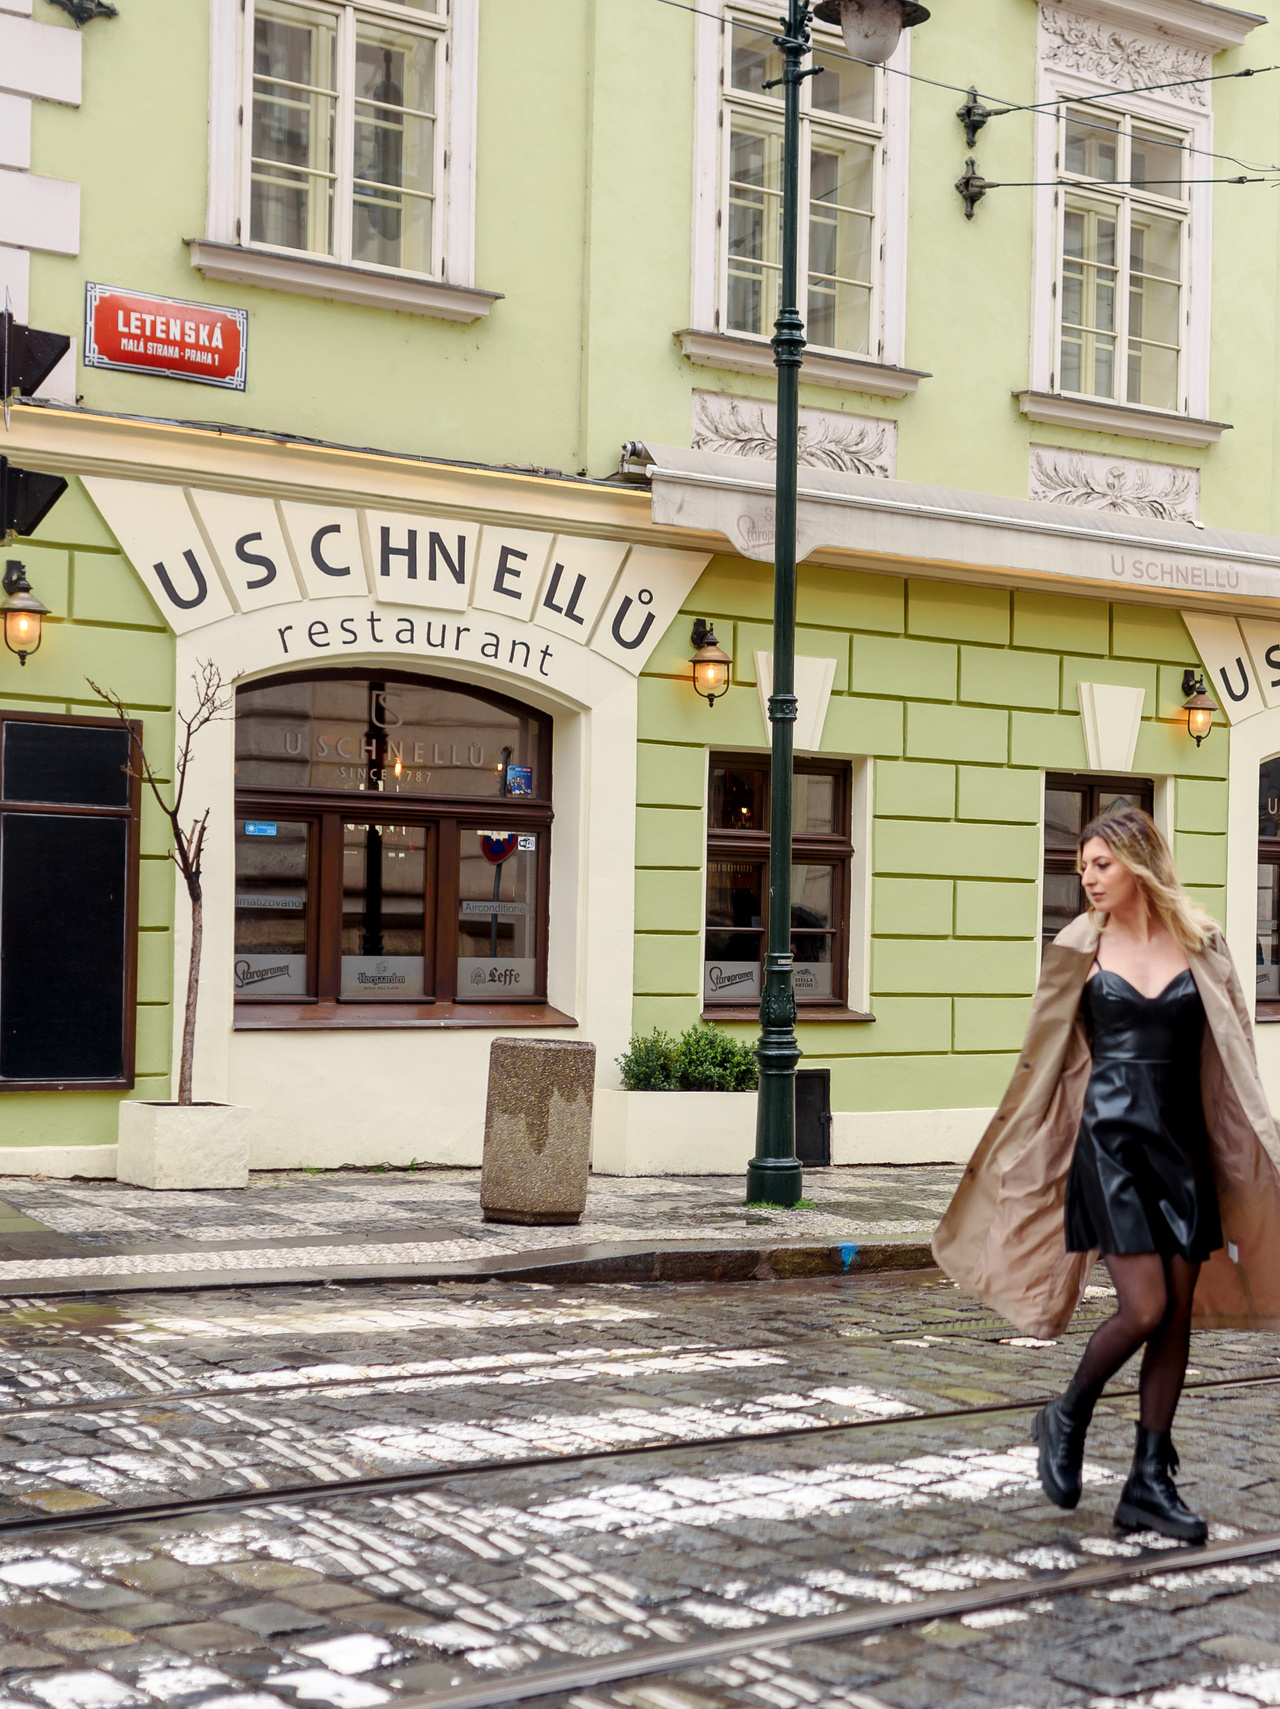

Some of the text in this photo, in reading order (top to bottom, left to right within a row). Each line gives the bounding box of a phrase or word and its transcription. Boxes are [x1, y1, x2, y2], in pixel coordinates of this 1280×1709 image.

[117, 309, 223, 349] LETENSKÁ
[120, 338, 144, 353] MALÁ
[147, 341, 179, 359] STRANA
[185, 348, 212, 365] PRAHA
[214, 353, 219, 366] 1
[1110, 554, 1239, 589] U SCHNELLŮ
[278, 609, 554, 677] restaurant
[285, 732, 485, 768] U SCHNELLŮ
[339, 766, 387, 780] SINCE
[1267, 797, 1278, 815] U
[234, 960, 291, 988] Staropramen
[357, 972, 406, 986] Hoegaarden
[487, 966, 520, 986] Leffe
[709, 966, 755, 992] Staropramen
